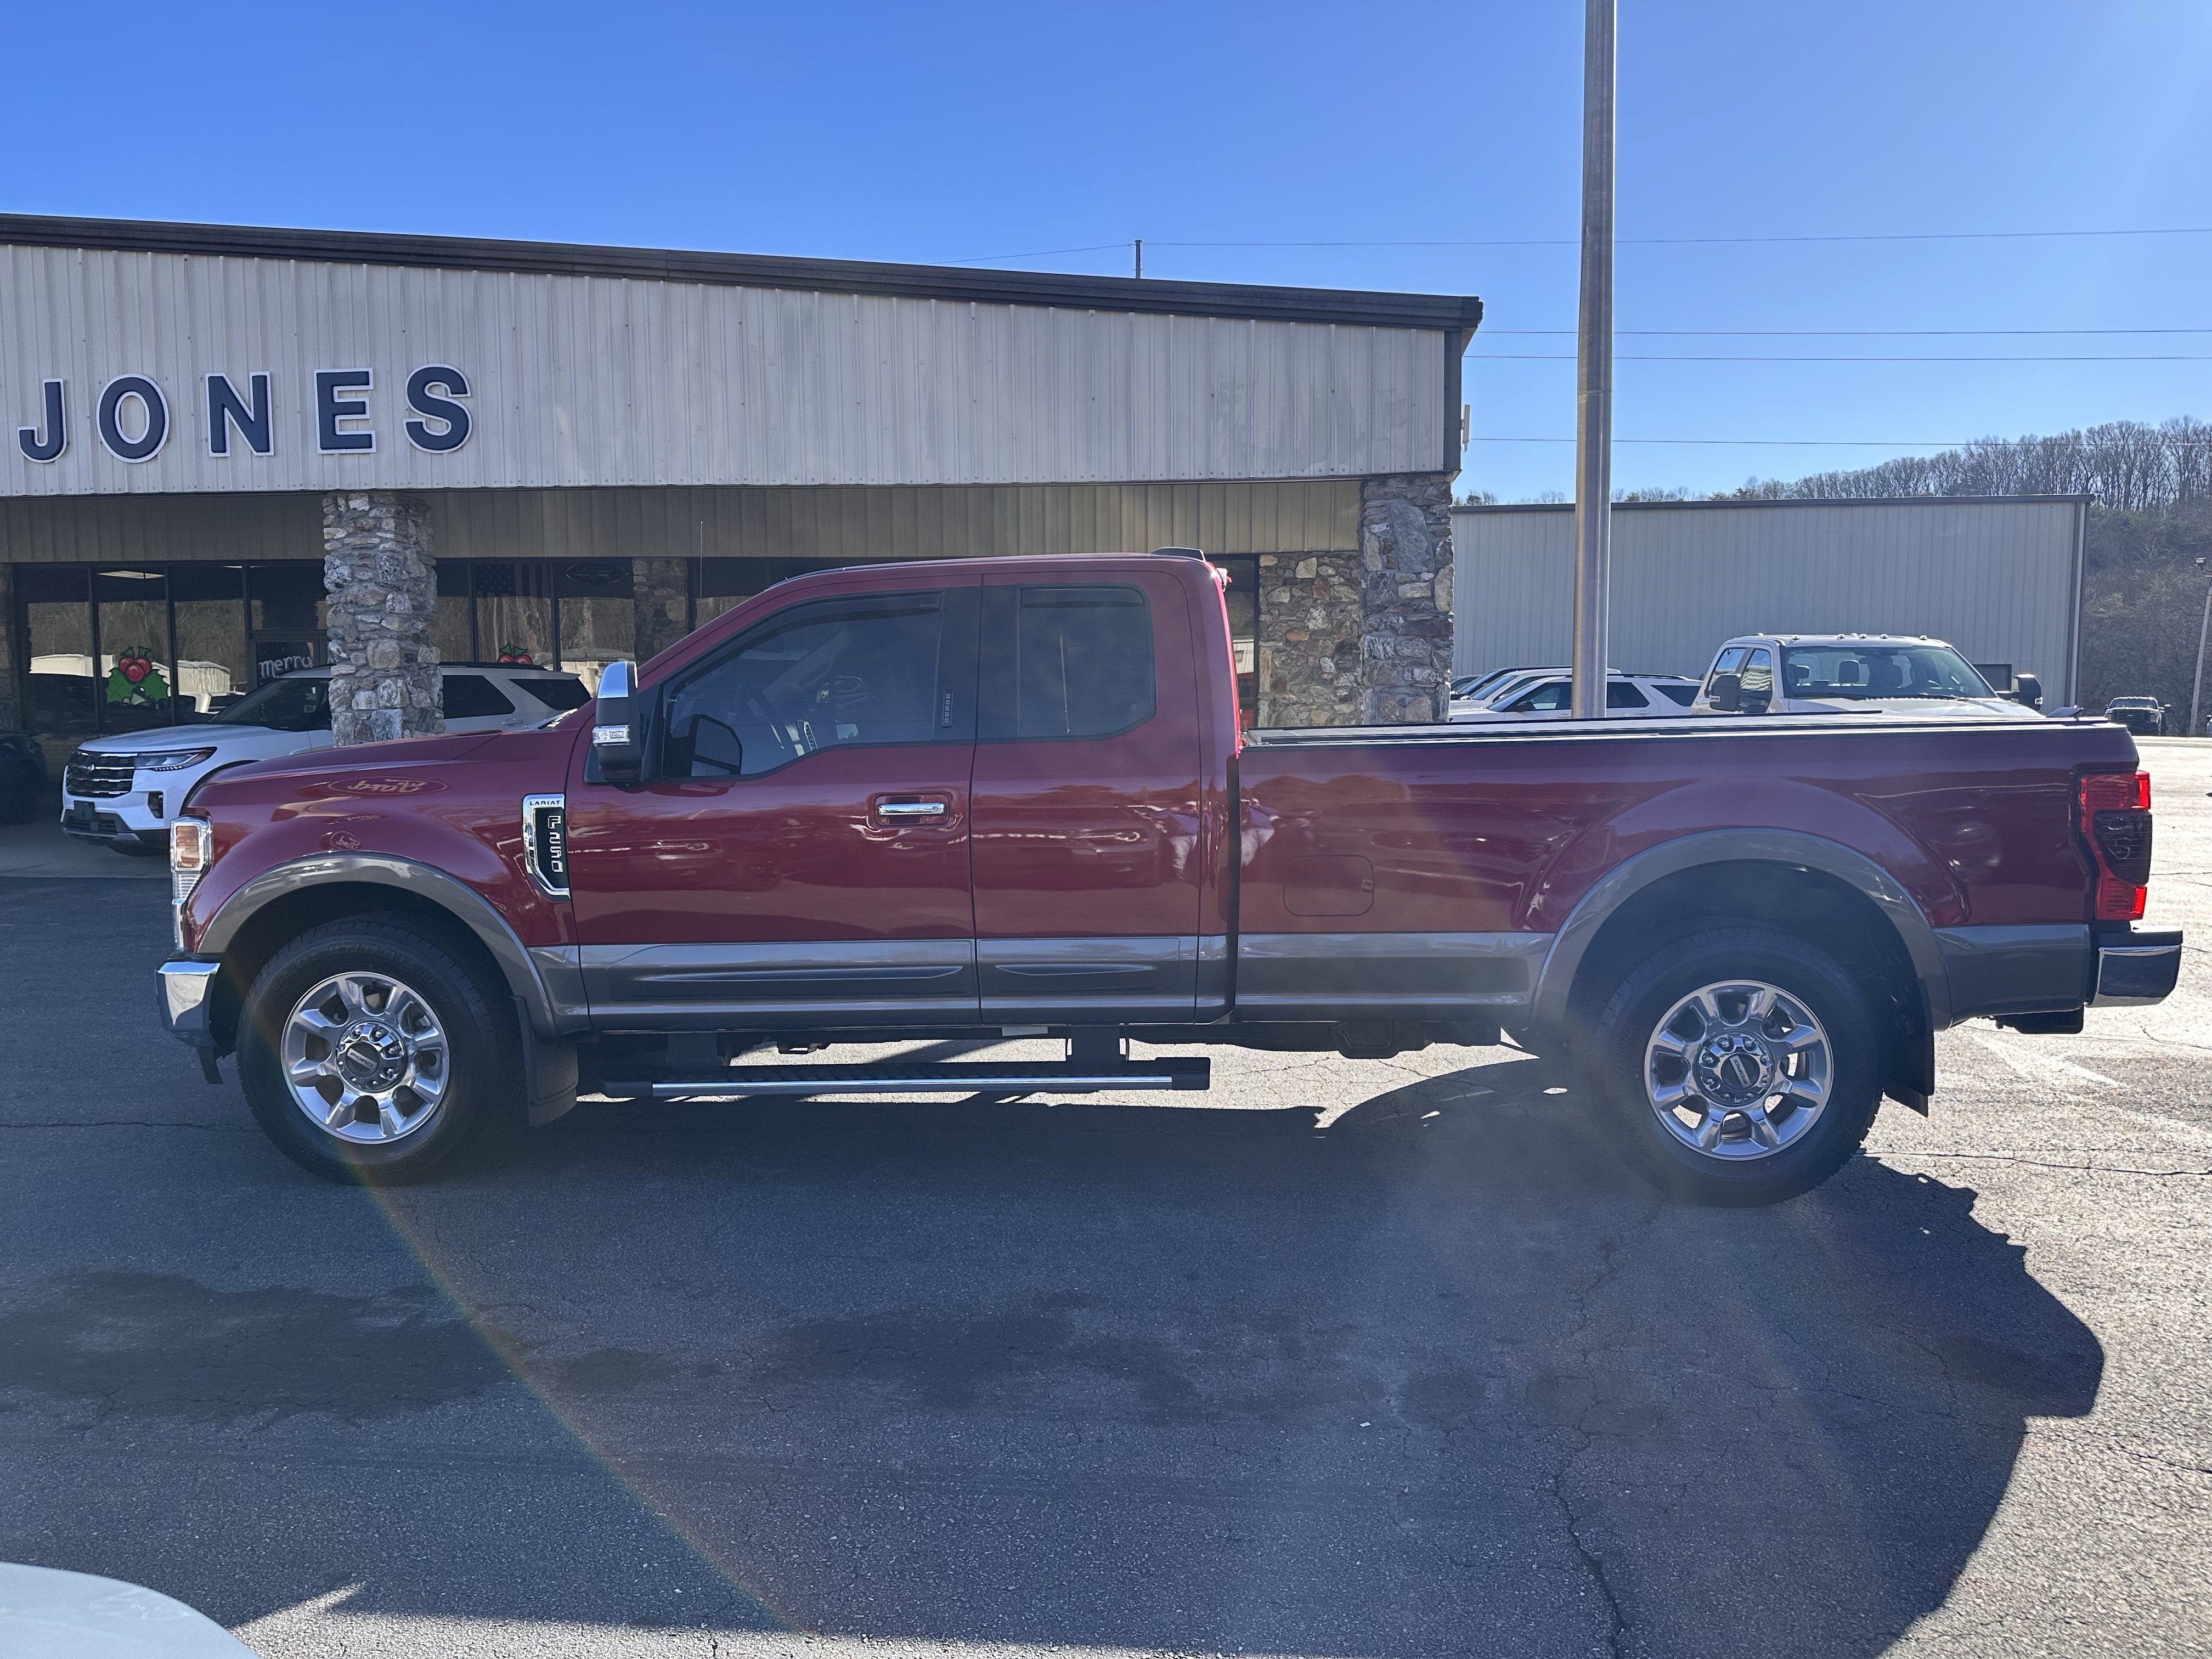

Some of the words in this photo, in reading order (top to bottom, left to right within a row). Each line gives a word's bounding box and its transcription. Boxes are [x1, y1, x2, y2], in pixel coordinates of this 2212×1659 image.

[18, 363, 472, 463] JONES
[350, 1052, 373, 1067] FORD
[1734, 1060, 1748, 1084] FORD
